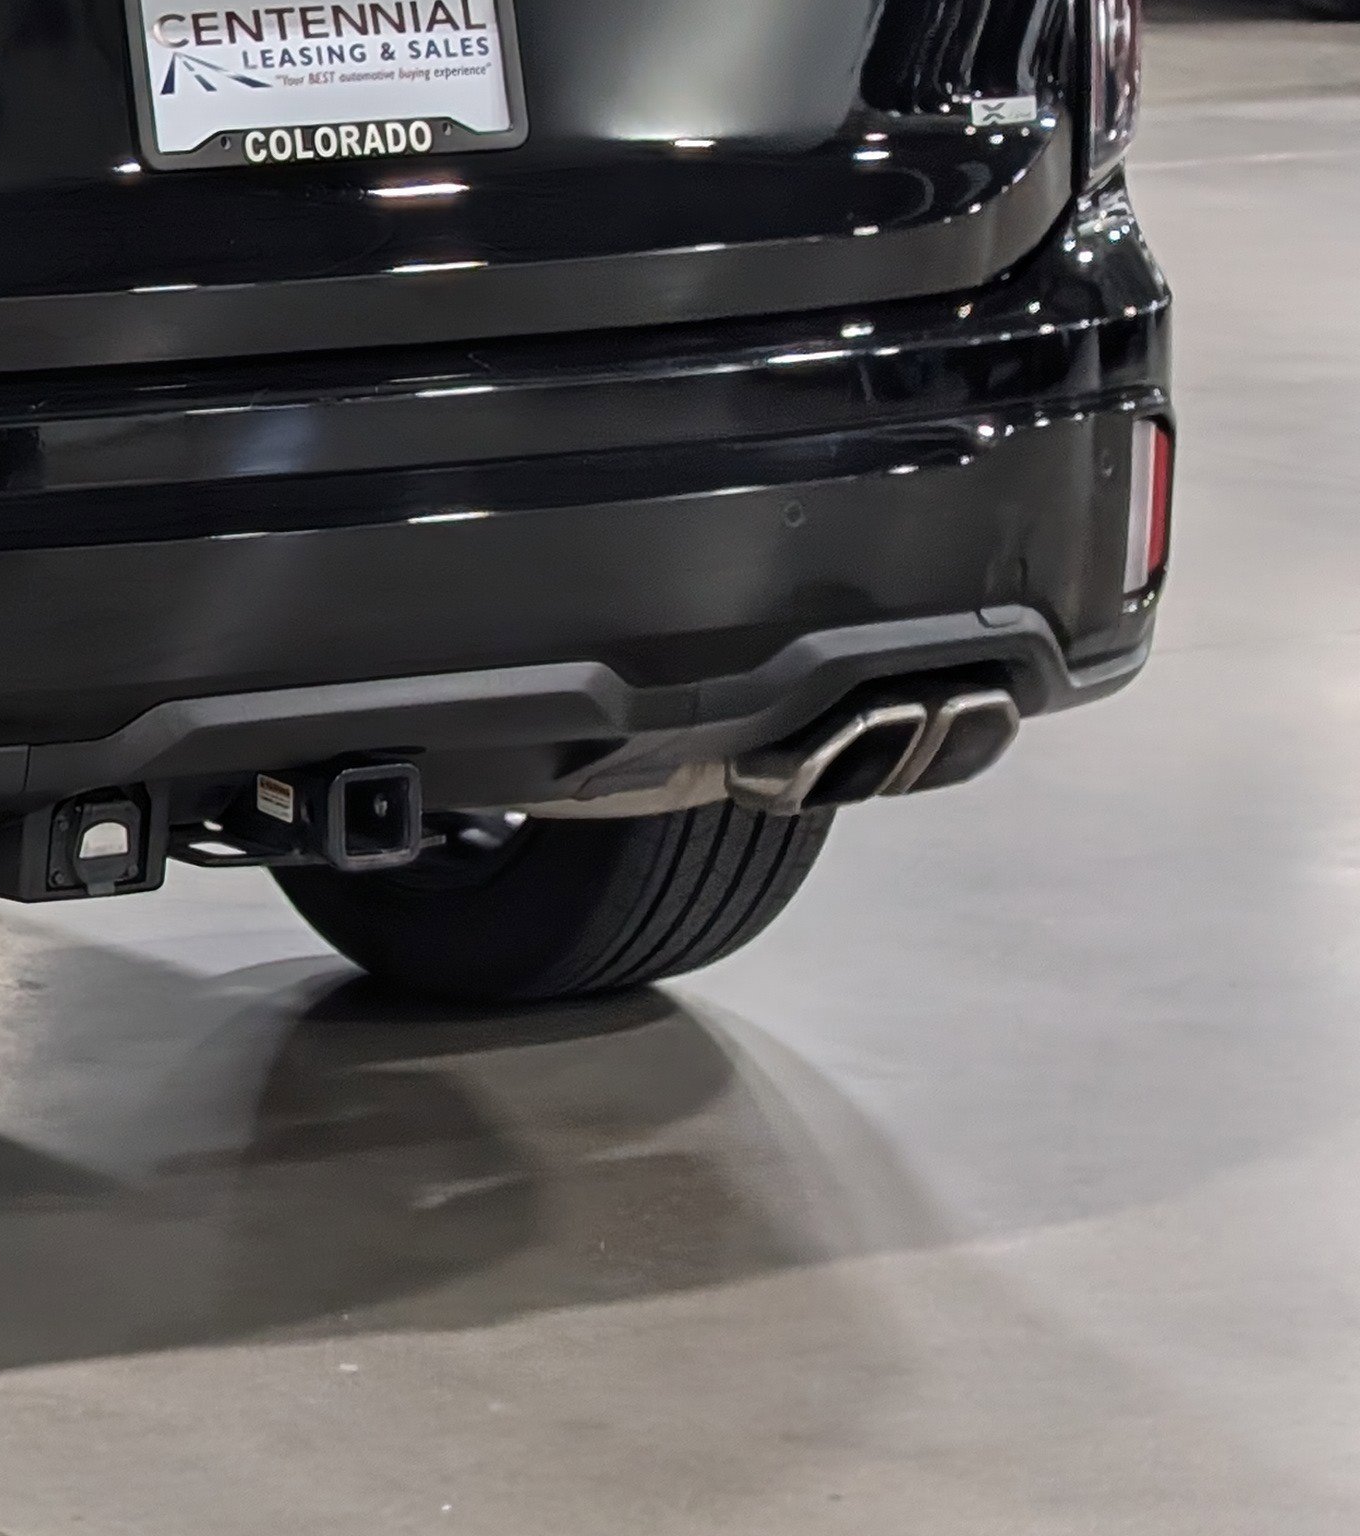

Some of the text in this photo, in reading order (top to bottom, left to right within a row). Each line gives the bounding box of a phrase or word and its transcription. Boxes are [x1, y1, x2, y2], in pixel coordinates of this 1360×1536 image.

[242, 36, 490, 70] LEASING & SALES
[308, 72, 336, 85] BEST
[339, 70, 395, 83] automotive
[398, 67, 430, 82] buying
[244, 120, 433, 163] COLORADO
